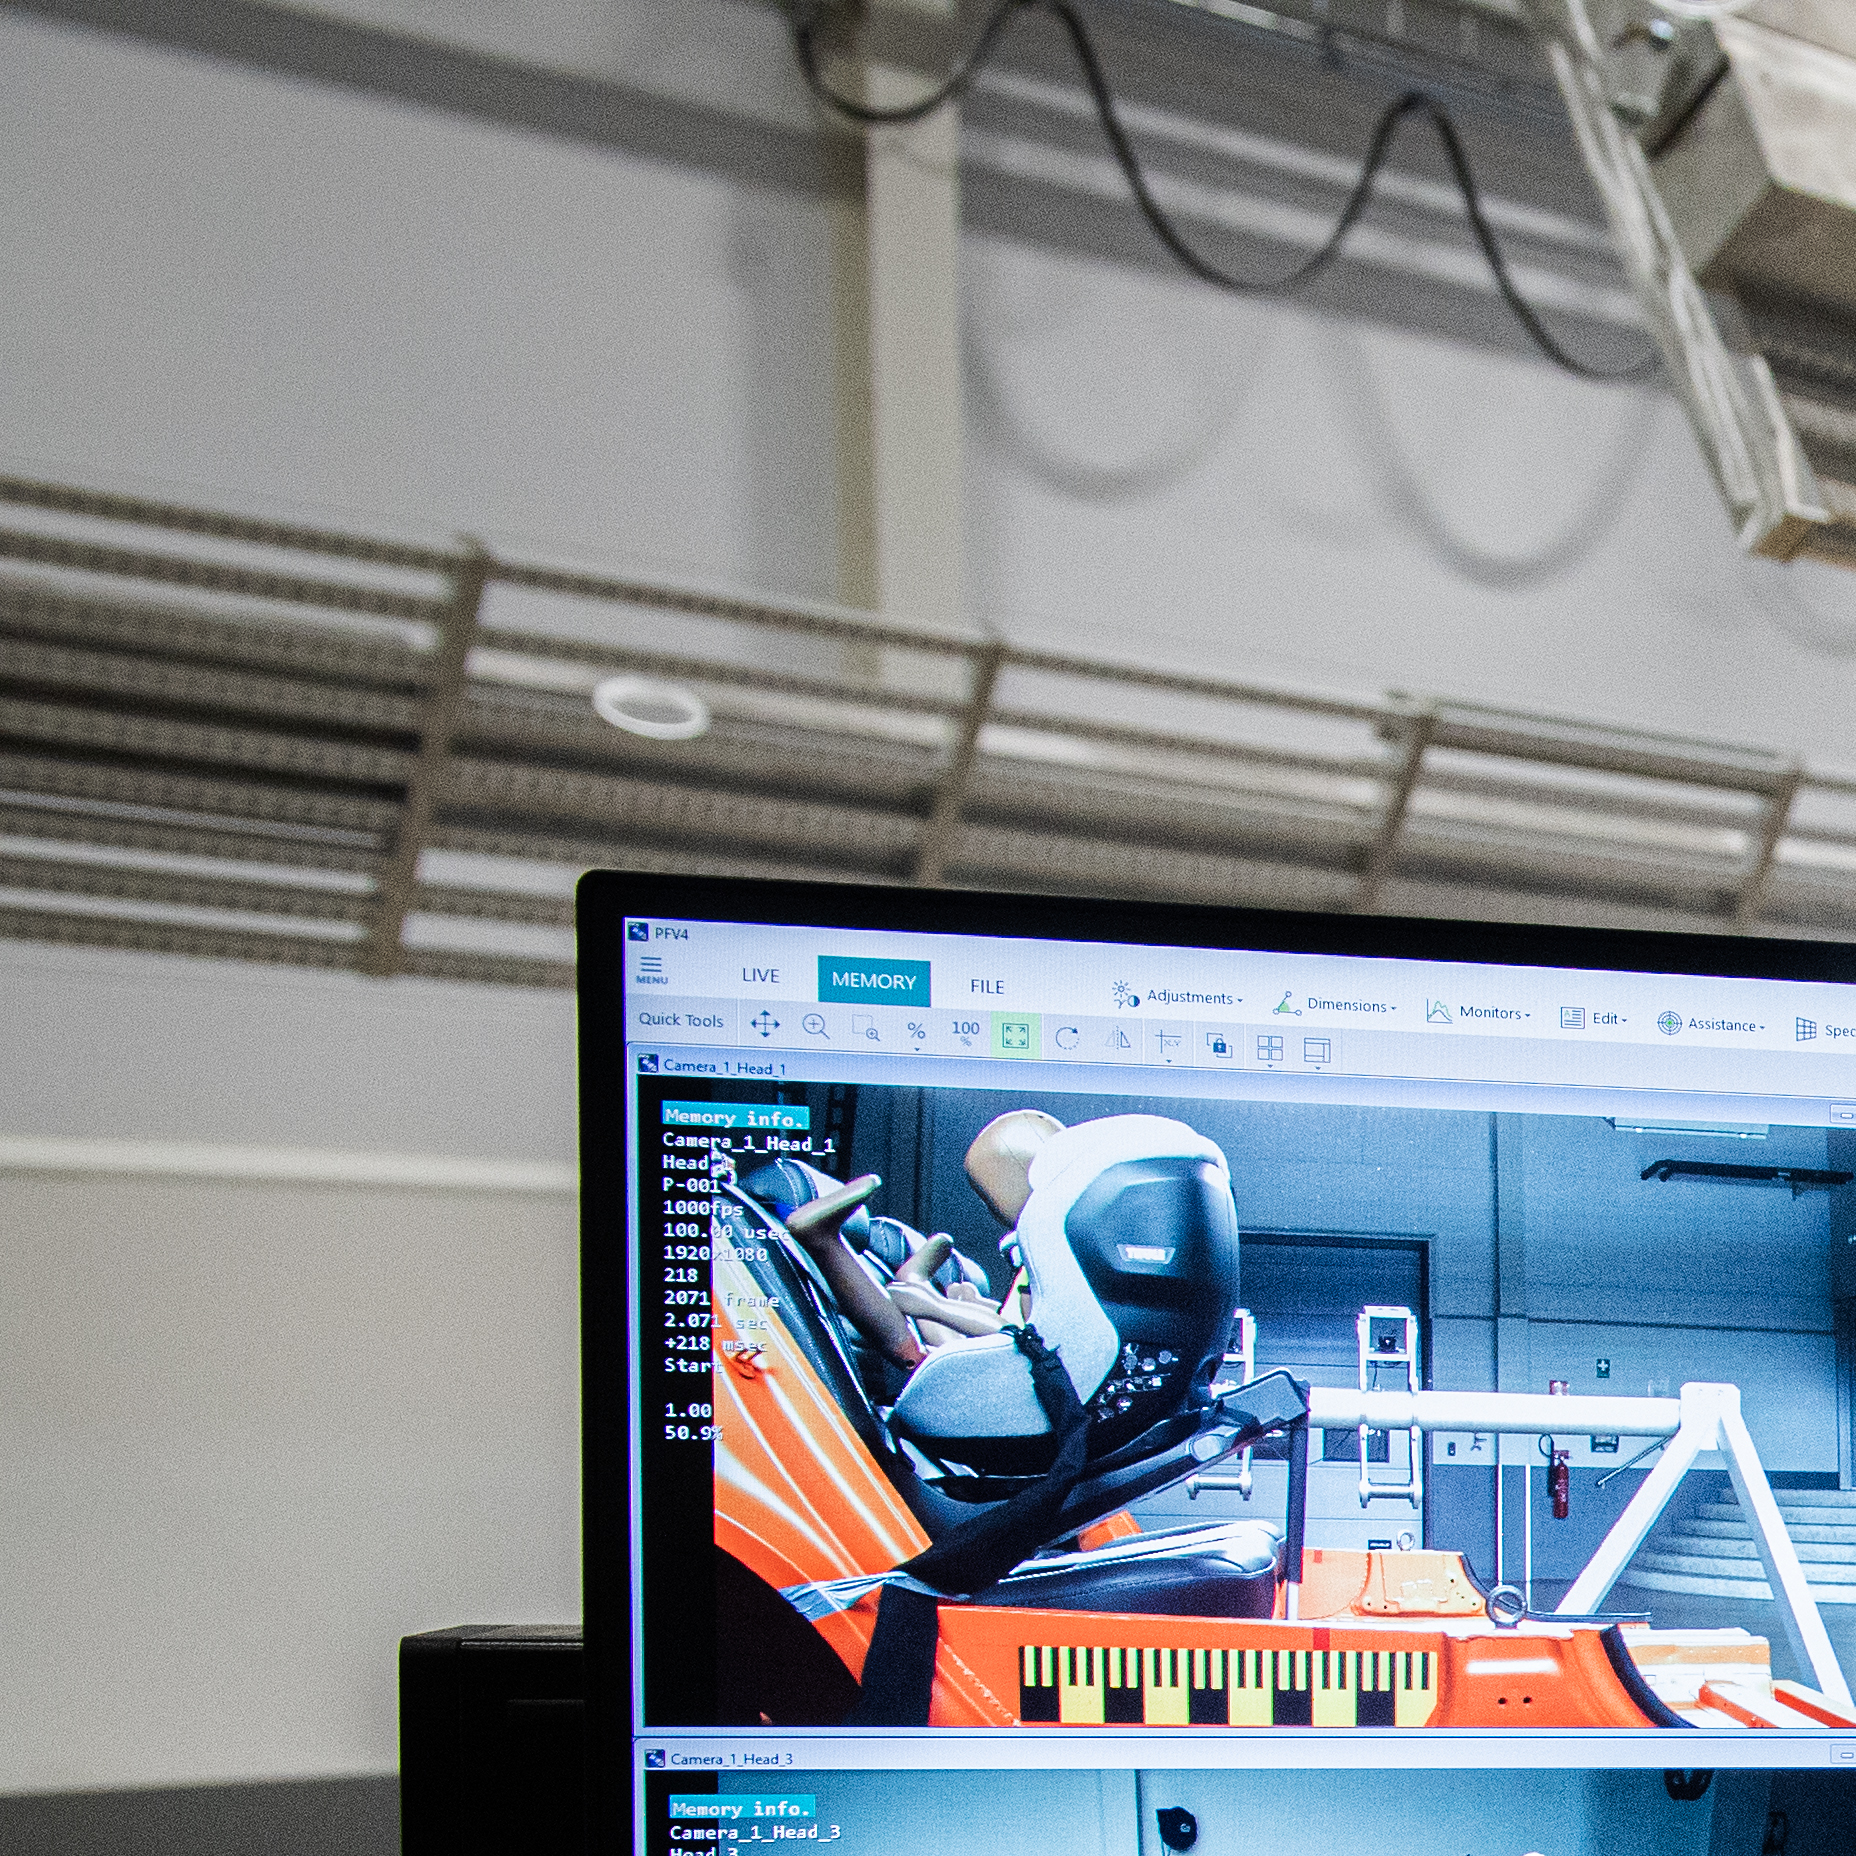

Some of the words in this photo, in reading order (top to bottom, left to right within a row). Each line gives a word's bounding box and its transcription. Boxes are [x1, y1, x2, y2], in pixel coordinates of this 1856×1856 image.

[655, 928, 688, 940] PFV4
[636, 976, 668, 984] MENU
[742, 968, 779, 983] LIVE
[832, 972, 916, 990] MEMORY
[971, 979, 1004, 994] FILE
[1147, 989, 1233, 1006] Adjustments
[1308, 998, 1387, 1013] Dimensions
[639, 1013, 680, 1028] Quick
[686, 1015, 723, 1028] Tools
[1460, 1006, 1521, 1021] Monitors
[1593, 1012, 1618, 1025] Edit
[952, 1022, 979, 1034] 100
[1689, 1018, 1756, 1033] Assistance
[664, 1059, 786, 1076] Camera_1_Head_1
[665, 1109, 736, 1128] Memory
[748, 1111, 802, 1128] info.
[663, 1132, 835, 1154] Camera_1_Head_1
[663, 1154, 709, 1170] Head
[663, 1178, 721, 1194] P-001
[663, 1201, 744, 1219] 1000fps
[663, 1223, 733, 1238] 100.00
[664, 1246, 767, 1261] 1920x1080
[664, 1268, 698, 1282] 218
[664, 1290, 710, 1305] 2071
[664, 1314, 721, 1328] 2.071
[665, 1336, 710, 1350] +218
[665, 1358, 723, 1373] Start
[665, 1403, 712, 1417] 1.00
[665, 1426, 723, 1440] 50.9%
[671, 1753, 793, 1767] Camera_1_Head_3
[672, 1803, 743, 1819] Memory
[754, 1801, 809, 1816] info.
[670, 1824, 841, 1842] Camera_1_Head_3
